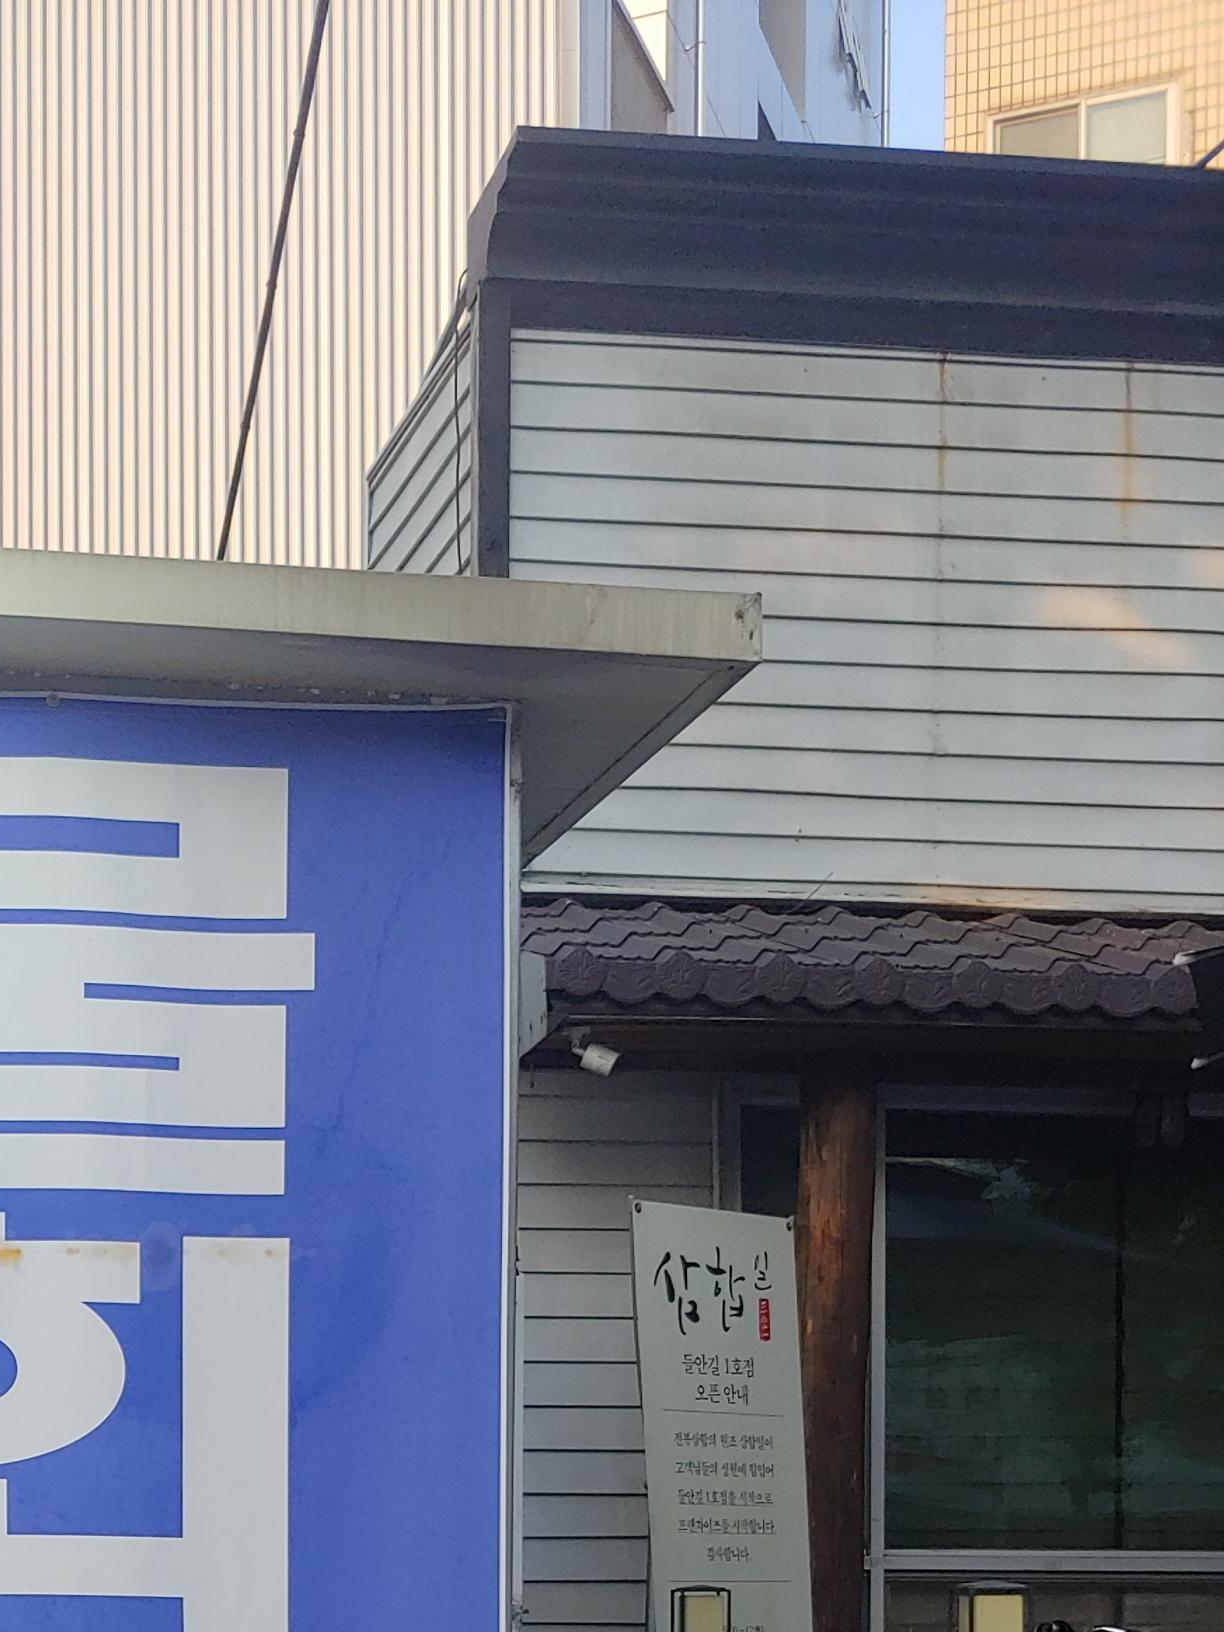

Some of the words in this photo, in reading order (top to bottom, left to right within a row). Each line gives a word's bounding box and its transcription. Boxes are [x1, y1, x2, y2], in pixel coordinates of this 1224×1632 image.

[681, 1354, 720, 1376] 들안길
[725, 1355, 755, 1378] 1호점
[695, 1384, 721, 1404] 오픈
[723, 1384, 749, 1405] 안내
